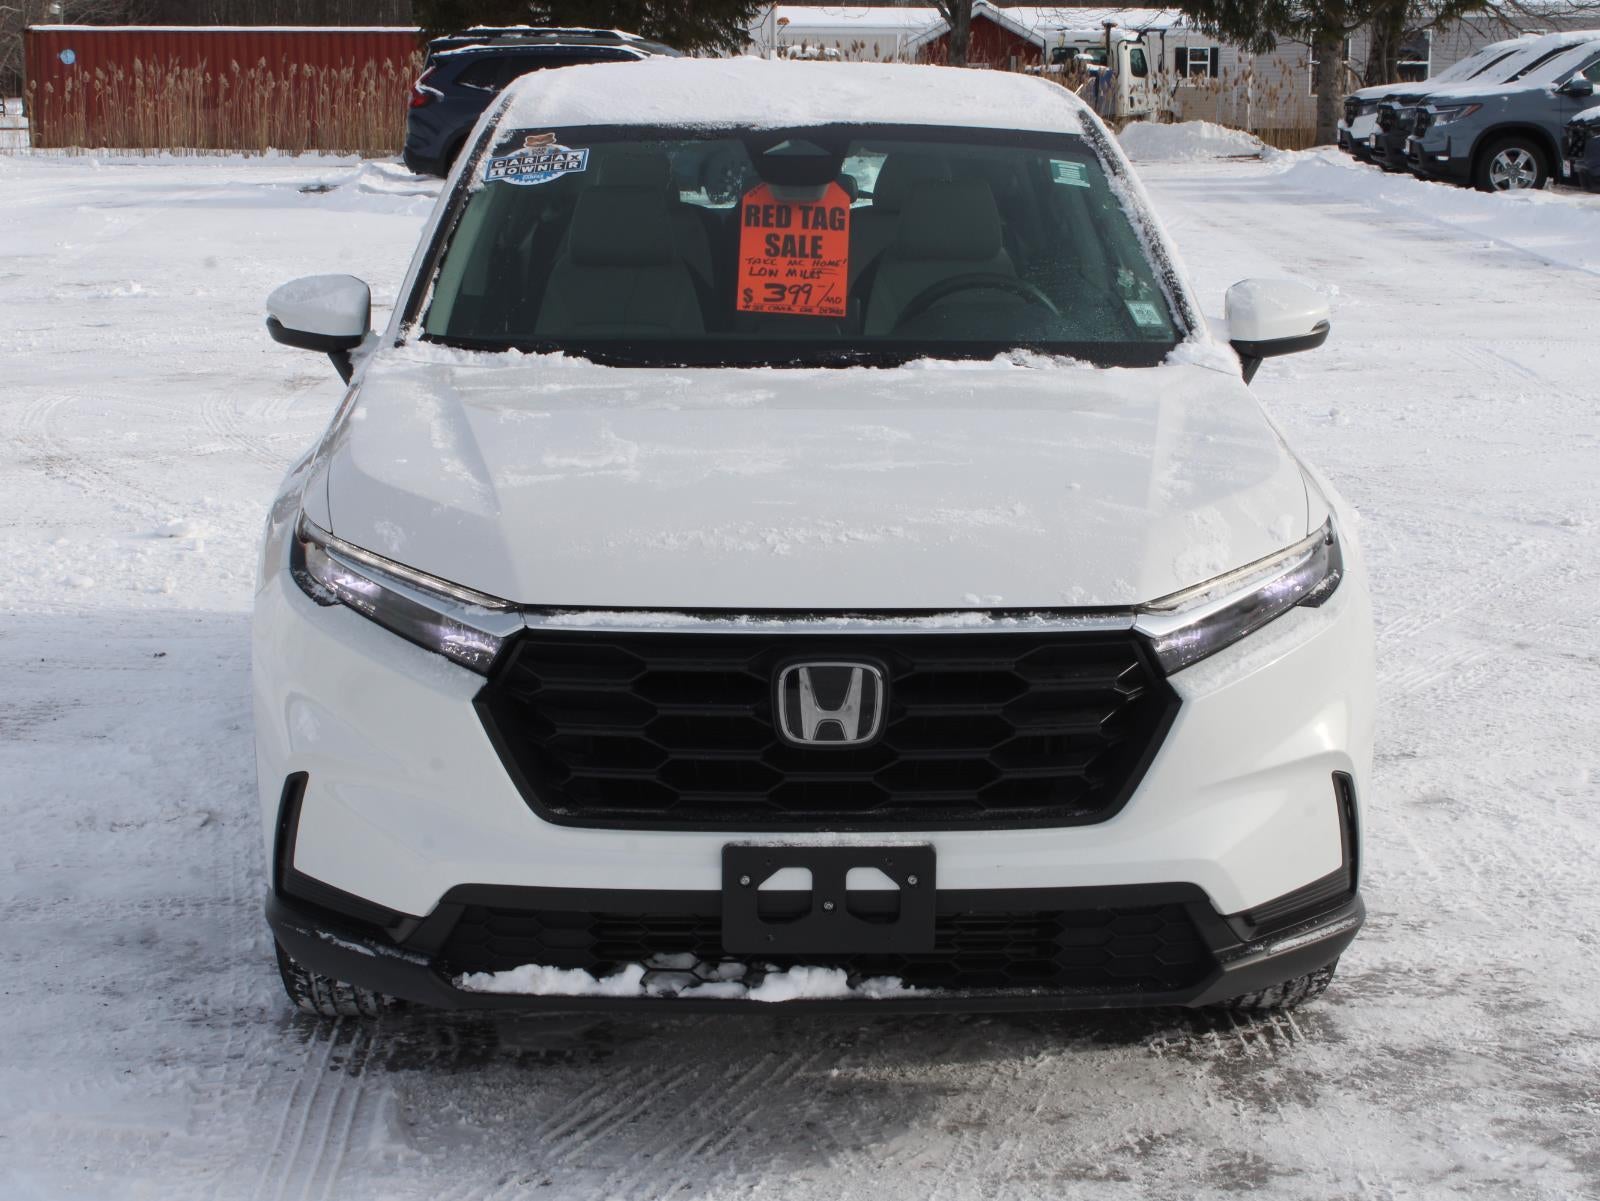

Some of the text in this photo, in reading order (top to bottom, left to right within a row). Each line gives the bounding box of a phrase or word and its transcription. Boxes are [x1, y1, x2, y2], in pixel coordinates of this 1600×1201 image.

[494, 153, 580, 168] CARFAX
[507, 162, 579, 174] OWNER
[744, 204, 846, 231] RED TAG
[765, 232, 823, 259] SALE
[749, 266, 823, 280] LOW MILES
